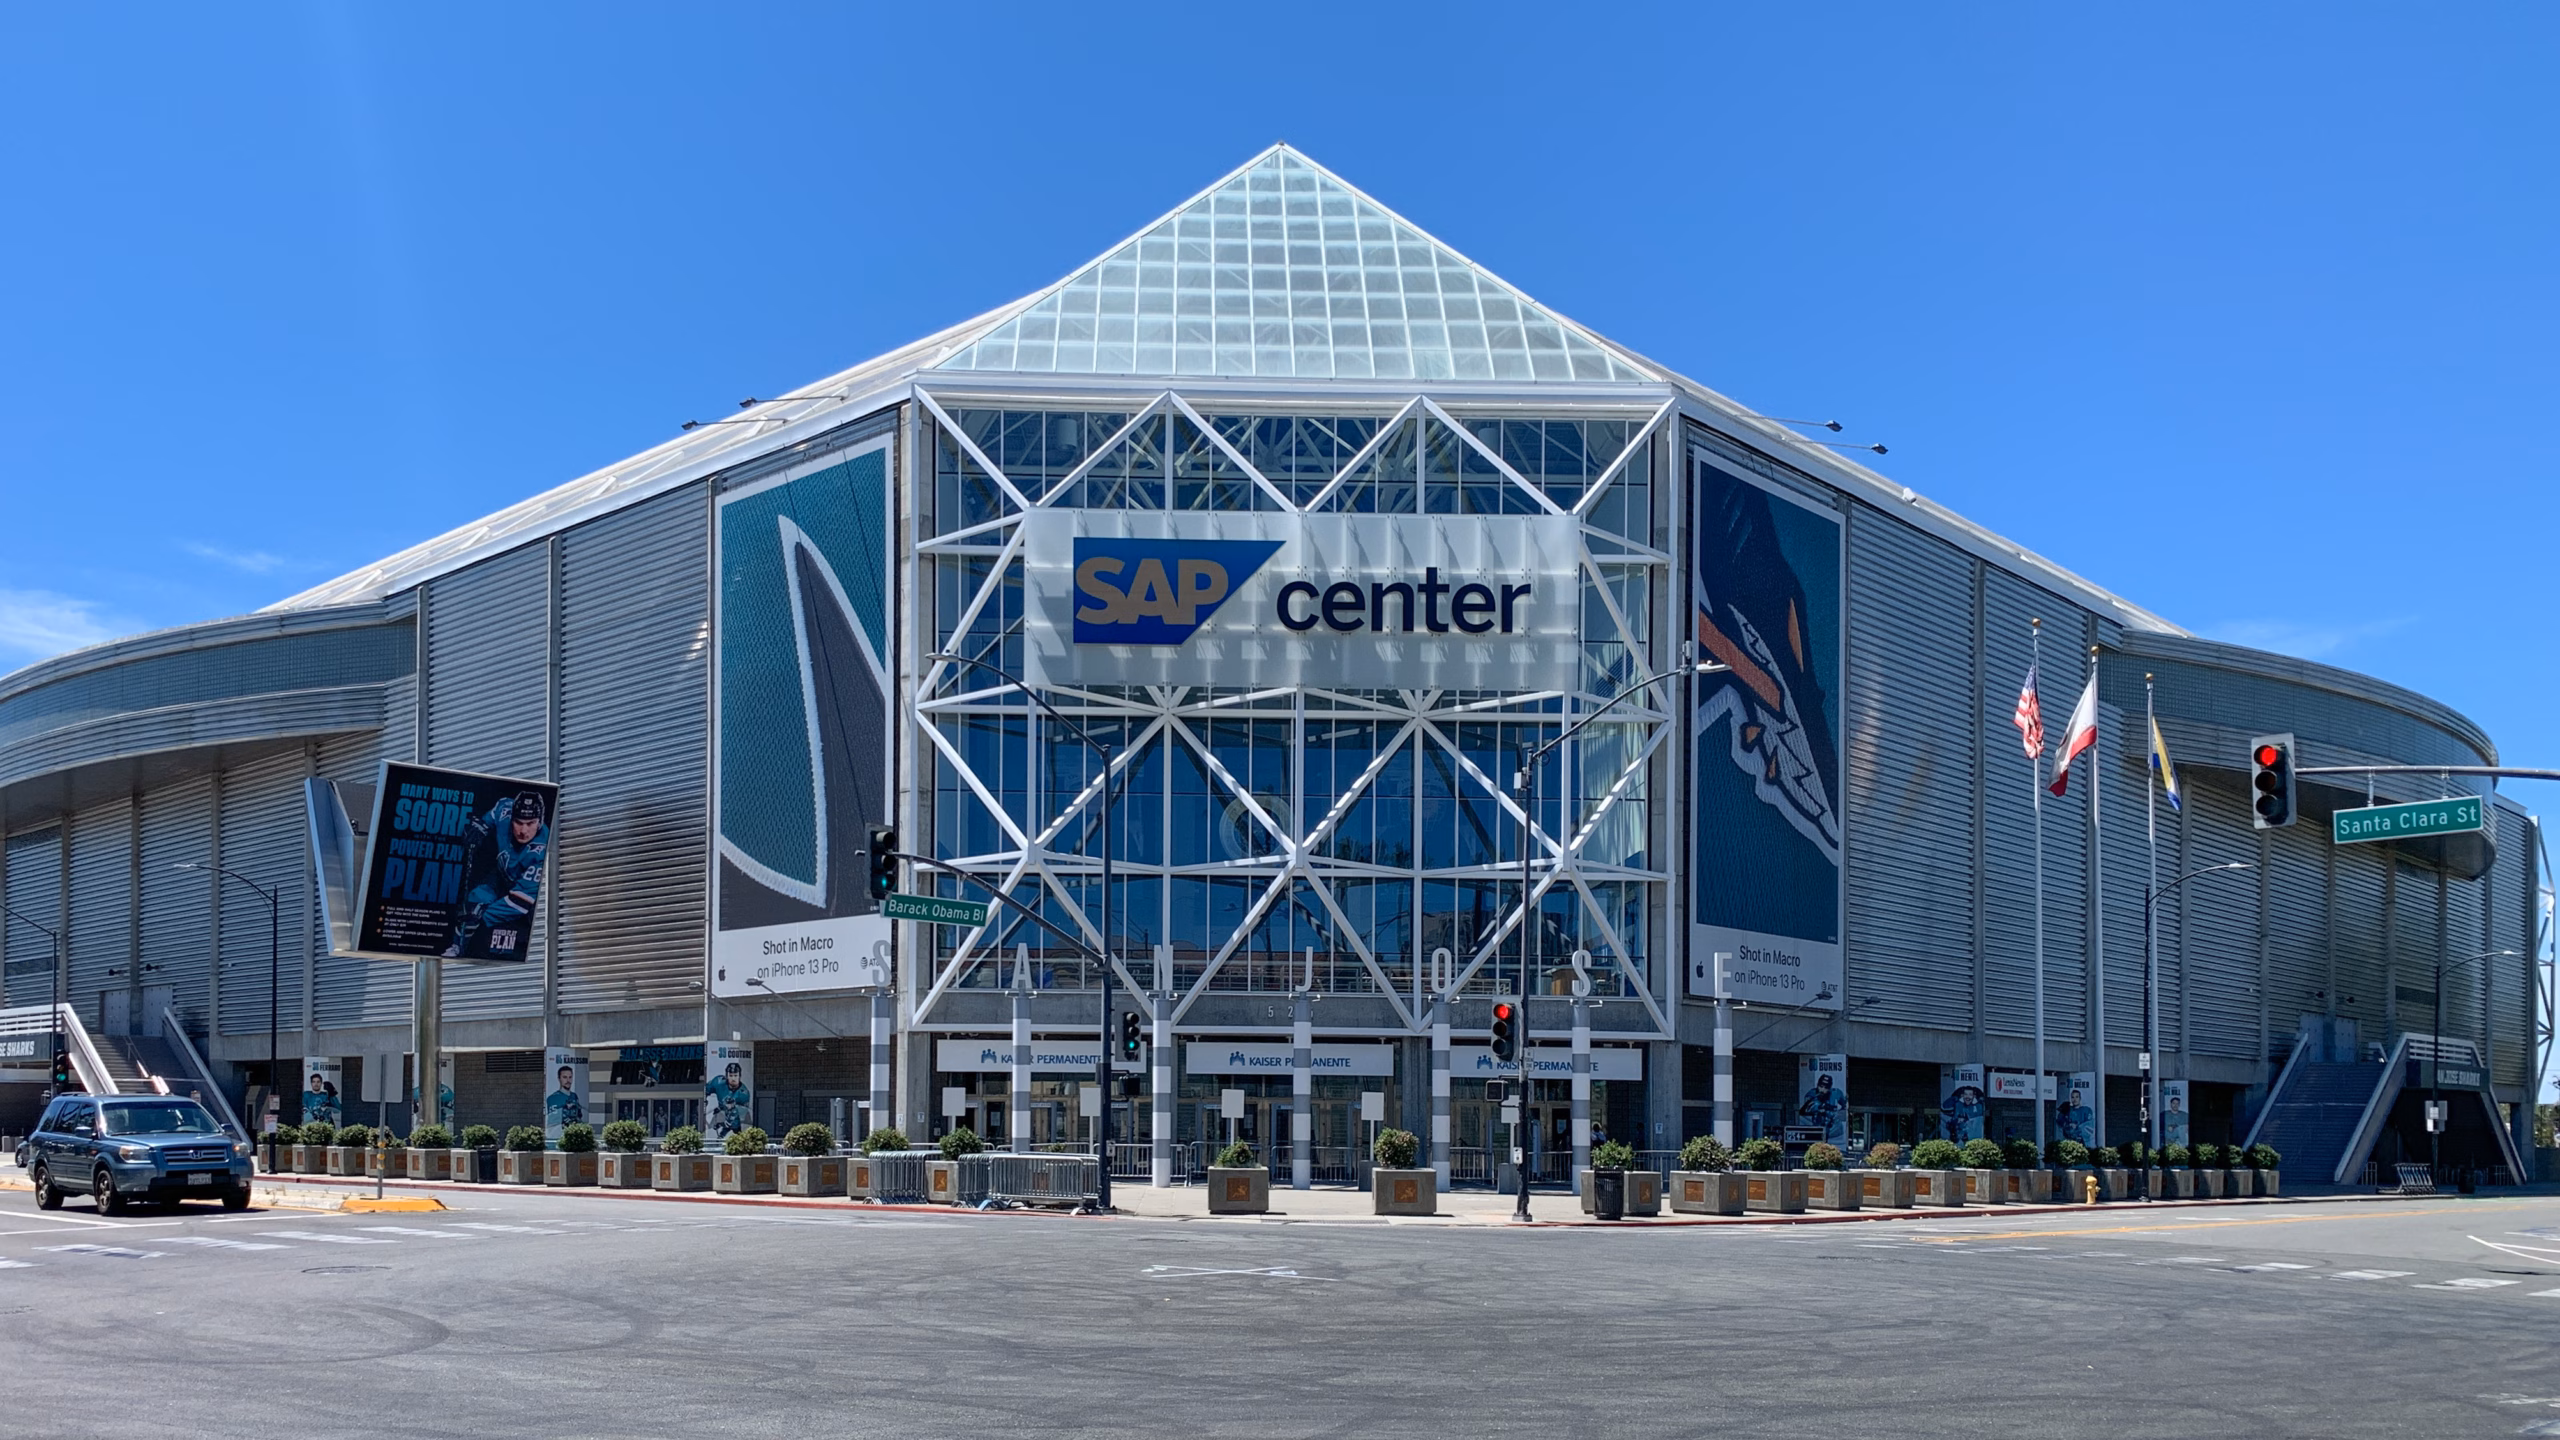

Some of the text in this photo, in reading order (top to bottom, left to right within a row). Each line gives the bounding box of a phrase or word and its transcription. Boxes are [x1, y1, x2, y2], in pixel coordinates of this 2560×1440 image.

[1075, 556, 1531, 635] SAP center
[400, 783, 474, 804] MANY WAYS TO
[2340, 806, 2477, 835] Santa Clara St
[389, 838, 464, 862] POWER PLAY
[381, 857, 463, 904] PLAN
[888, 900, 984, 922] Barack Obama Bl
[490, 935, 516, 950] PLAN
[762, 936, 834, 955] Shot in Macro
[1740, 945, 1801, 967] Shot in Macro
[757, 959, 839, 979] on iPhone 13 Pro
[1734, 970, 1805, 990] on iPhone 13 Pro
[7, 1041, 35, 1057] SHARKS
[728, 1050, 752, 1058] COUTURE
[1249, 1056, 1282, 1067] KAISER
[1819, 1061, 1843, 1072] BURNS
[1960, 1072, 1979, 1081] HERTL
